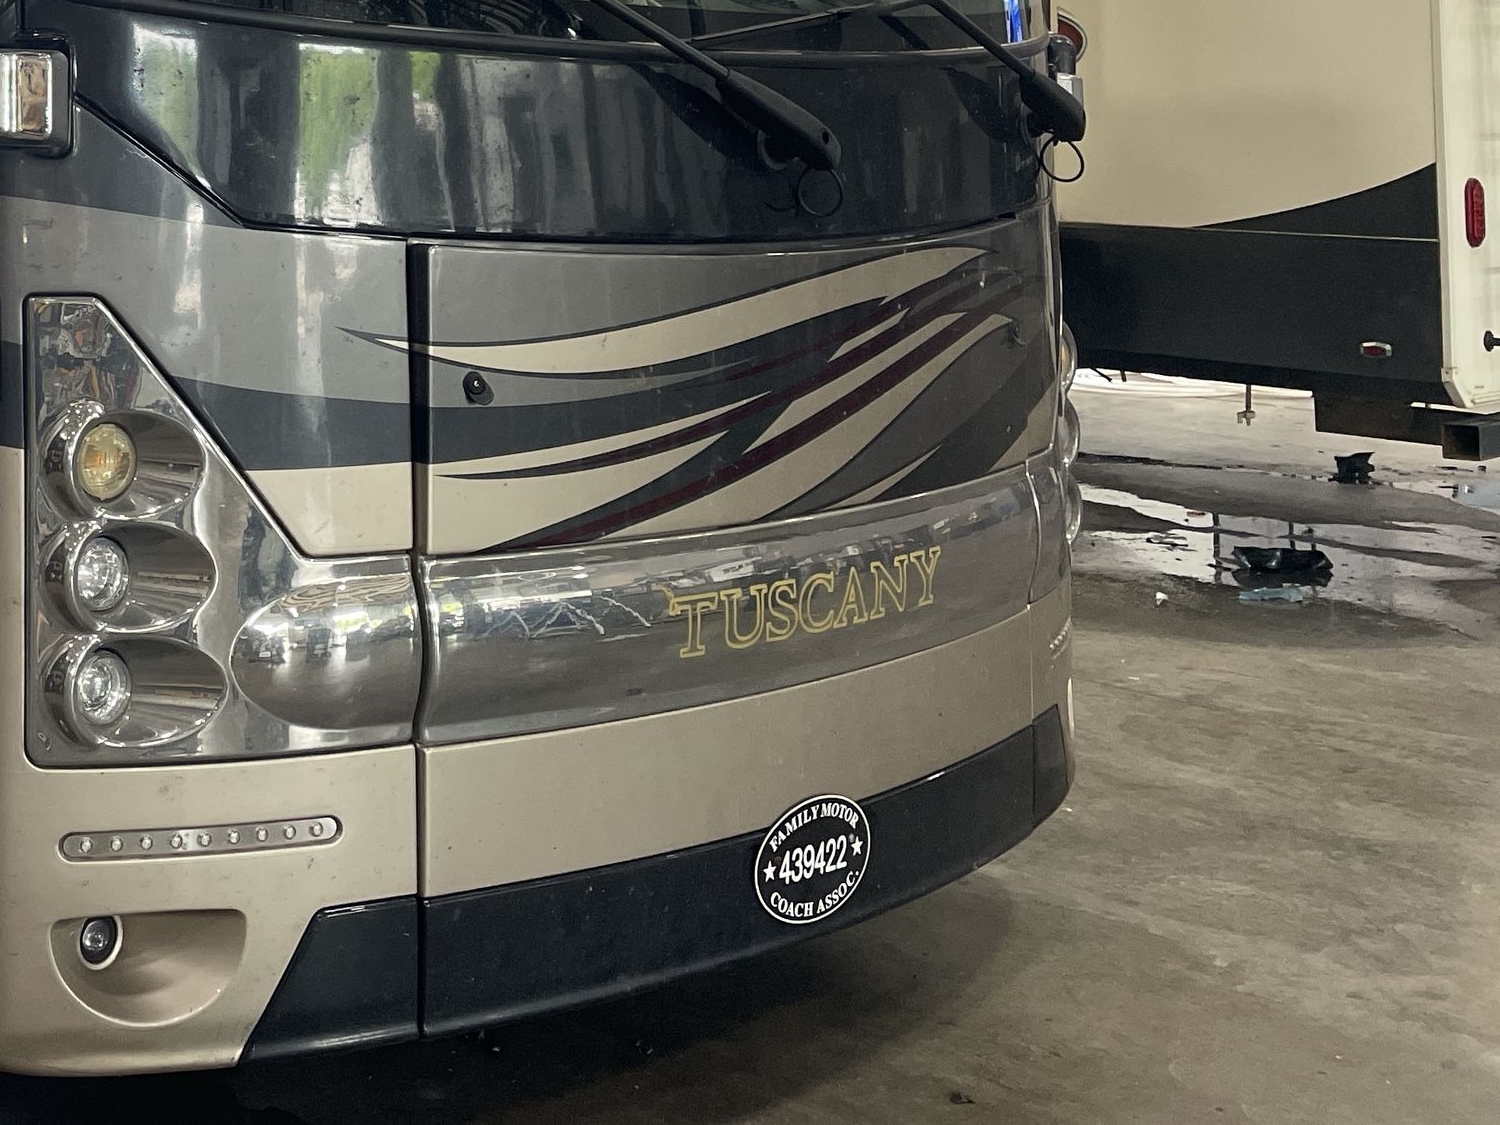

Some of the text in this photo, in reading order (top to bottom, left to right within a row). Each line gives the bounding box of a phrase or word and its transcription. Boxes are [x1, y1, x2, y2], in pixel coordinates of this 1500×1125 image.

[669, 545, 941, 659] TUSCANY
[769, 802, 860, 853] FAMILY MOTOR
[778, 834, 848, 885] 439422
[770, 870, 860, 918] COACH ASSOC.
